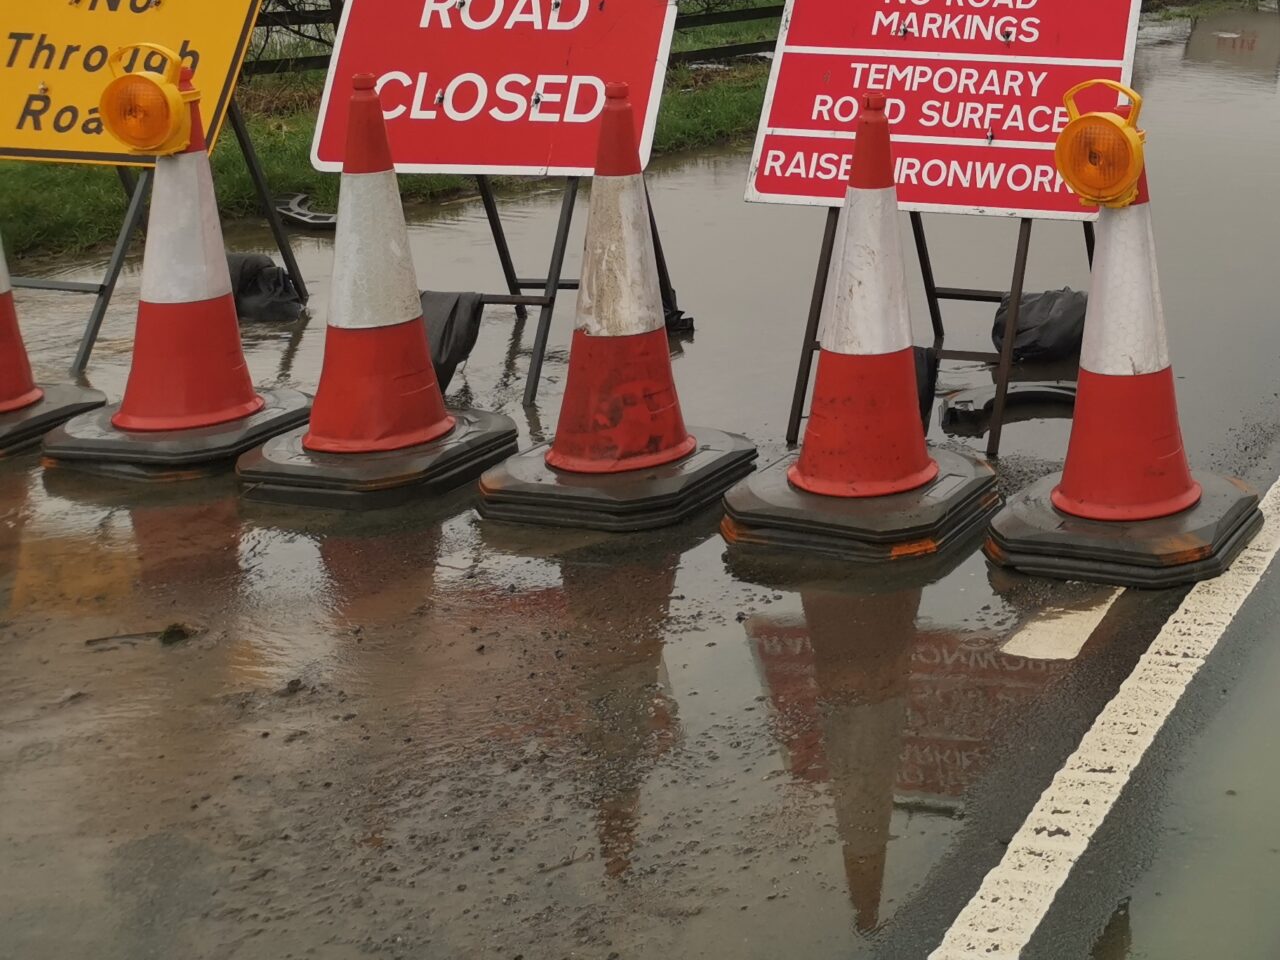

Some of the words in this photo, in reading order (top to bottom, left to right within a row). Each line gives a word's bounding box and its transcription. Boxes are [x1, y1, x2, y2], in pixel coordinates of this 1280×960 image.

[871, 11, 1041, 43] MARKINGS
[375, 71, 606, 123] CLOSED
[850, 63, 1048, 97] TEMPORARY
[16, 94, 104, 134] Roa
[811, 94, 906, 124] ROD
[918, 100, 1071, 134] SURFACE
[763, 150, 853, 181] RAISE
